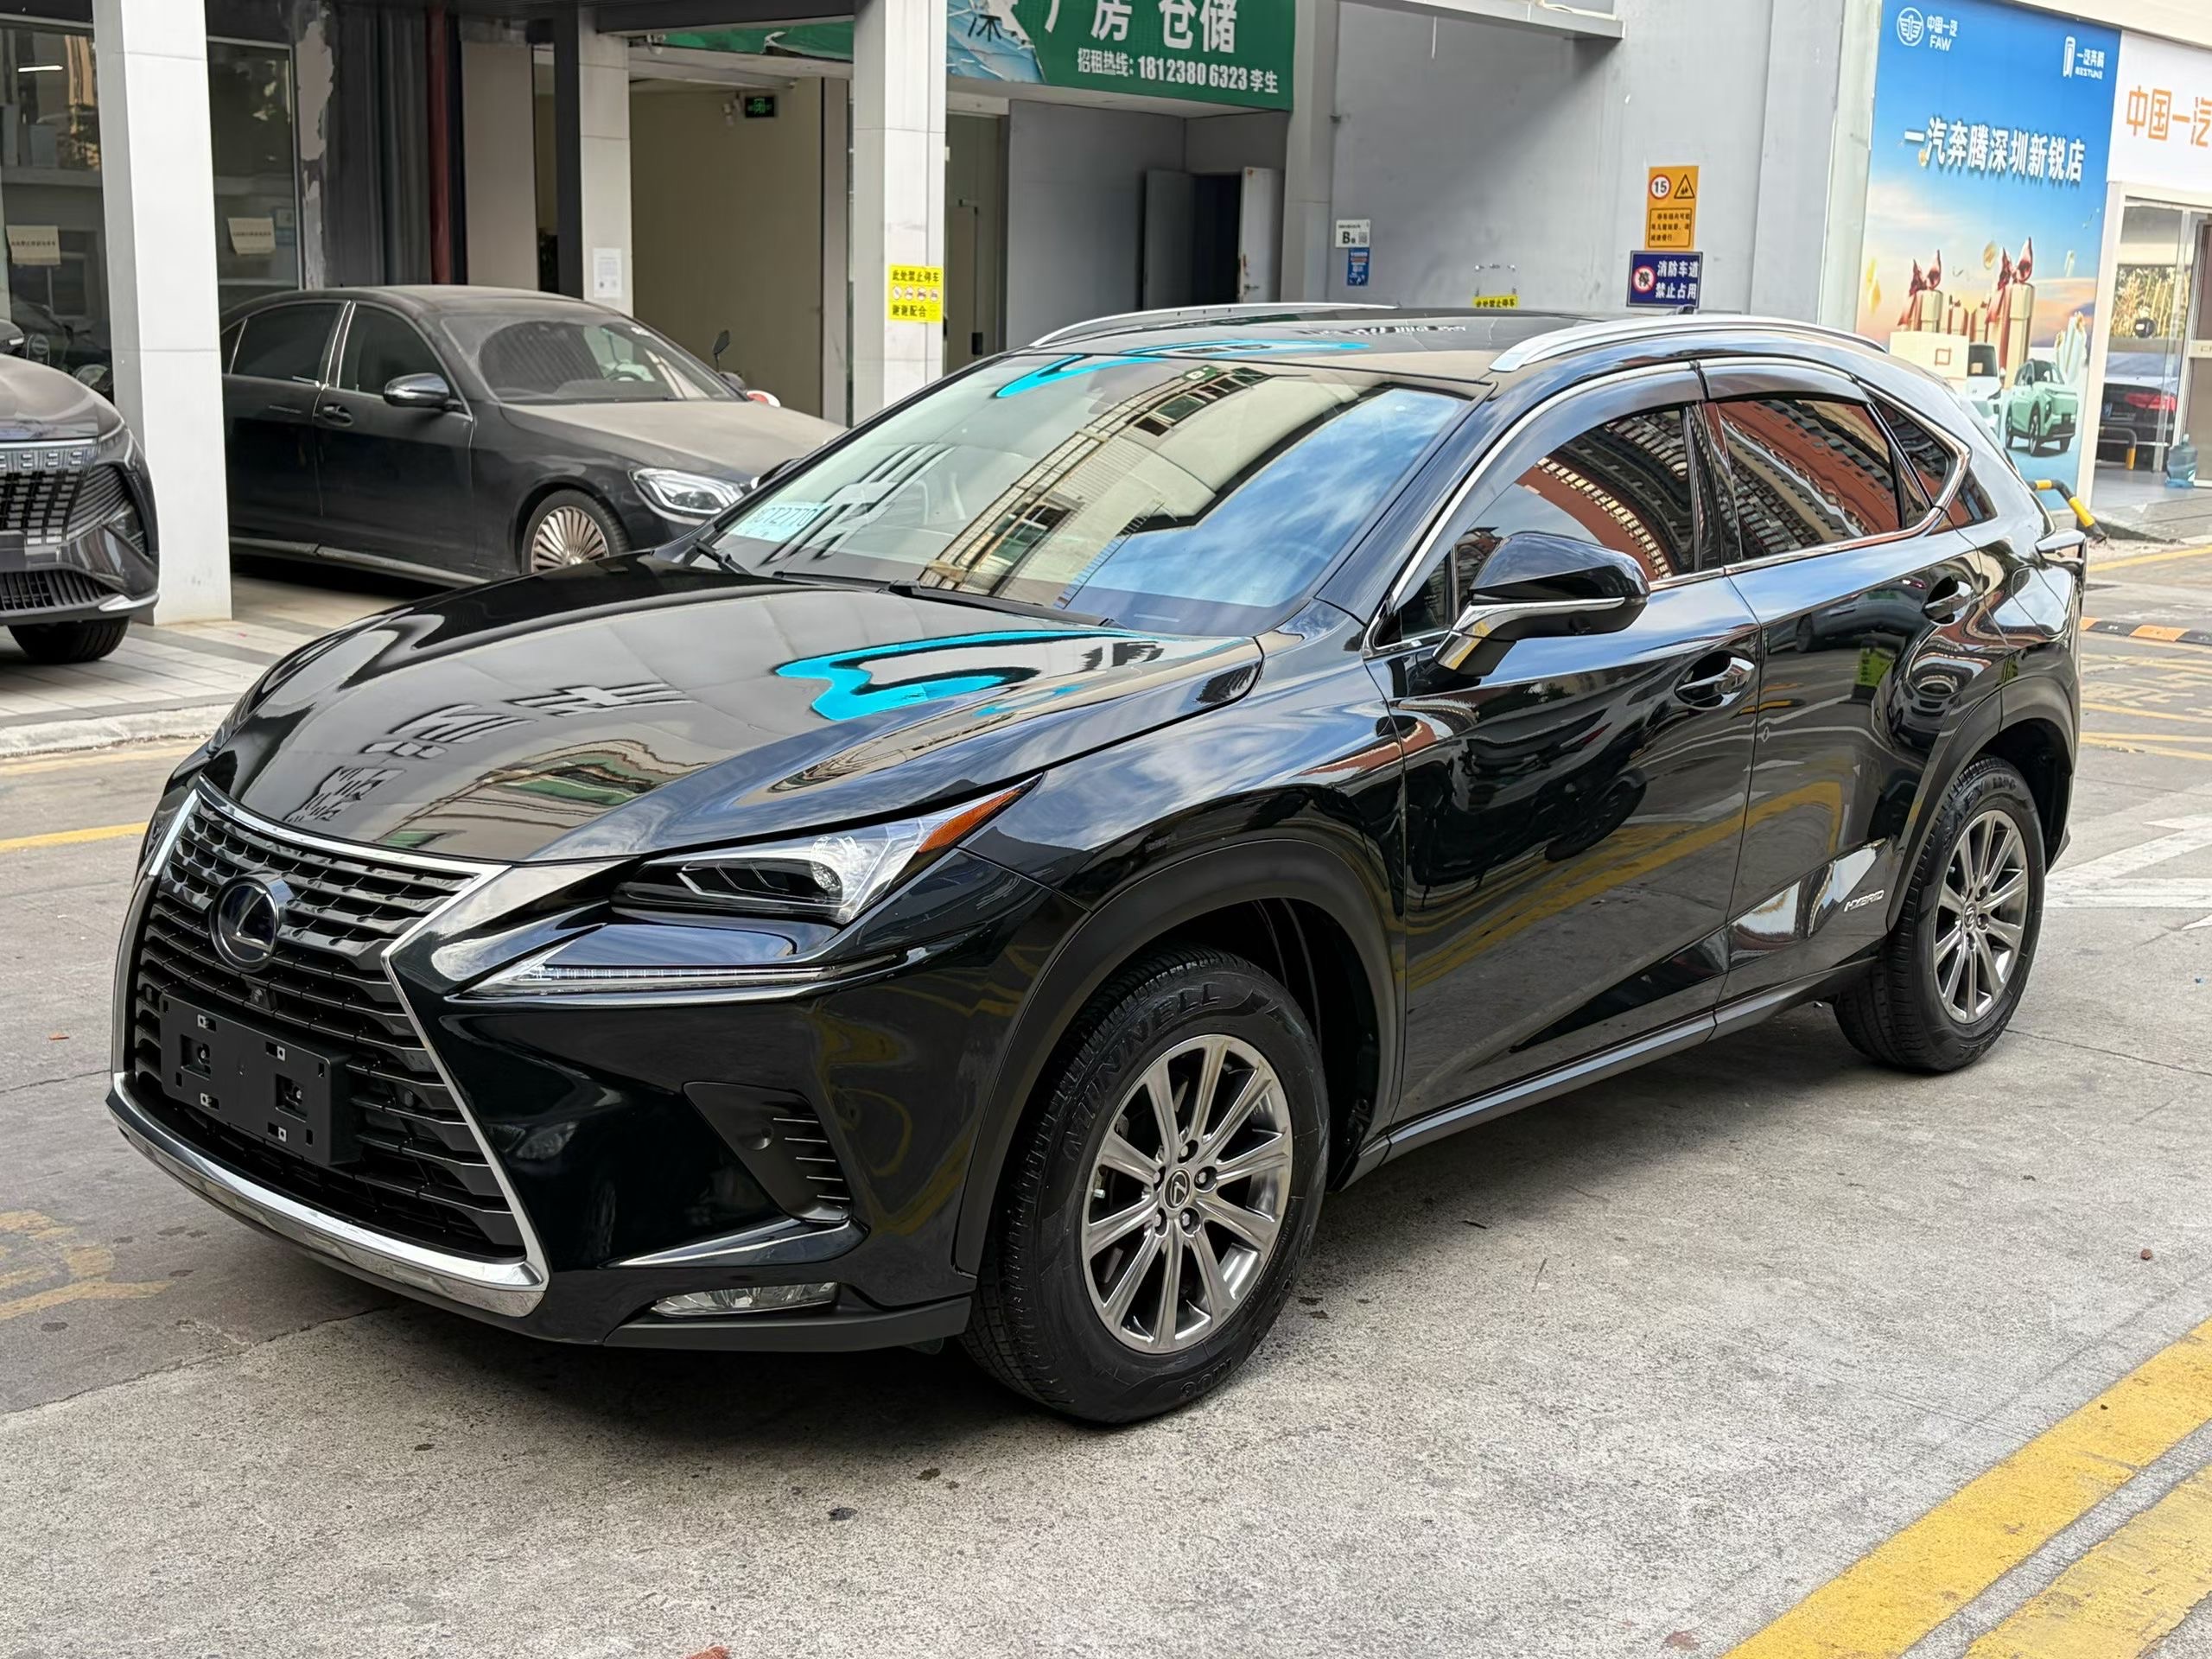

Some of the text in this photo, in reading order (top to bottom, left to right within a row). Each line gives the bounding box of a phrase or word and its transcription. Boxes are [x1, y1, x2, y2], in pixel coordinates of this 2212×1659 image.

[1158, 0, 1238, 54] 仓储
[1929, 35, 1953, 51] FAW
[1077, 47, 1279, 94] 招租热线： 18123806323 李生
[2126, 85, 2212, 148] 中国一汽
[1904, 117, 2086, 181] 一汽奔腾深圳新锐店
[1654, 181, 1668, 194] 15
[1656, 282, 1697, 299] 禁止占用
[1843, 889, 1885, 912] HYBRID
